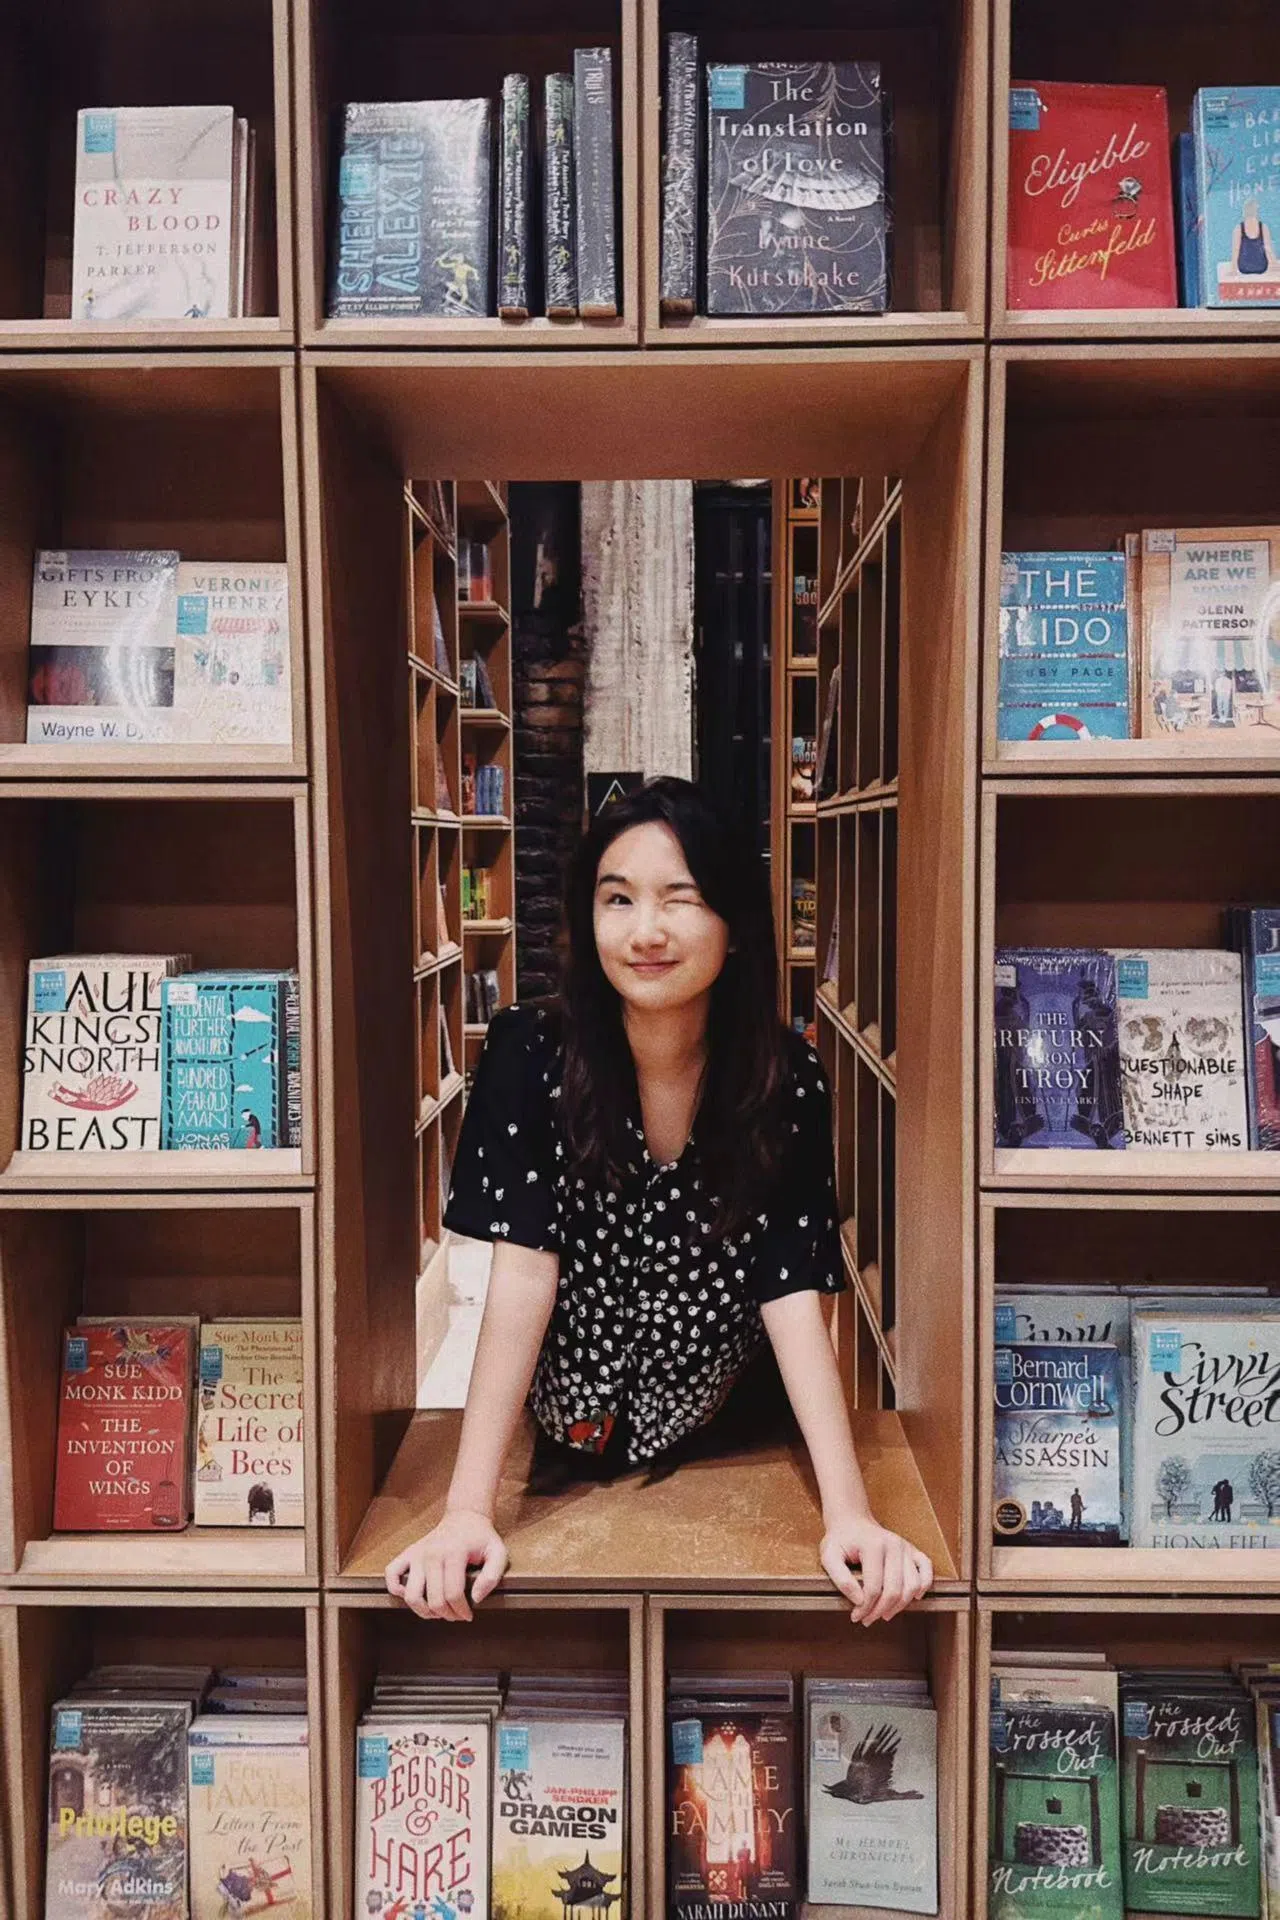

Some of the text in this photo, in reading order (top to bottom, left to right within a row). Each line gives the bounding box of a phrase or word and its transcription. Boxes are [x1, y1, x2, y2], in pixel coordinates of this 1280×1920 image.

[769, 78, 814, 101] The
[717, 114, 867, 138] Translation
[742, 149, 843, 172] of Love
[1024, 123, 1150, 208] Eligible
[83, 188, 183, 207] CRAZY
[128, 215, 221, 231] BLOOD
[376, 134, 424, 293] ALEXIE
[758, 226, 830, 250] Lynne
[1057, 219, 1109, 245] Curtis
[117, 243, 217, 256] JEFFERSON
[1029, 218, 1156, 286] Sittenfeld
[87, 265, 157, 277] PARKER
[728, 261, 860, 288] Kutsukake
[1187, 549, 1255, 563] WHERE
[114, 568, 157, 582] FRO
[1019, 570, 1097, 598] THE
[1184, 567, 1256, 581] ARE WE
[192, 577, 284, 592] VERONIC
[64, 590, 149, 608] EYKIS
[211, 595, 284, 610] HENRY
[1198, 605, 1244, 615] GLENN
[1015, 617, 1111, 646] LIDO
[1182, 619, 1257, 629] PATTERSON
[1071, 668, 1113, 677] PAGE
[42, 723, 94, 740] Wayne
[101, 723, 118, 737] W.
[64, 971, 162, 1013] AUL
[175, 1018, 228, 1036] FURTHER
[1038, 1013, 1068, 1025] THE
[32, 1016, 162, 1044] KINGS
[1000, 1029, 1104, 1048] RETURN
[23, 1047, 159, 1073] SNORTH
[1016, 1068, 1093, 1089] TROY
[1015, 1096, 1099, 1105] LINDSAY CLARKE
[1151, 1083, 1203, 1105] SHAPE
[177, 1111, 227, 1128] MAN
[29, 1117, 158, 1150] BEAST
[176, 1133, 230, 1143] JONAS
[1123, 1130, 1195, 1147] BENNETT
[214, 1330, 304, 1342] Sue Monk Ki
[104, 1365, 143, 1379] SUE
[242, 1367, 284, 1386] The
[1012, 1353, 1089, 1380] Bernard
[1163, 1342, 1280, 1397] Civvy
[65, 1386, 183, 1400] MONK KIDD
[221, 1384, 304, 1410] Secret
[994, 1375, 1107, 1408] Cornwell
[1155, 1388, 1280, 1437] Street
[101, 1418, 142, 1433] THE
[216, 1416, 304, 1443] Life of
[67, 1440, 175, 1455] INVENTION
[1009, 1418, 1099, 1458] Sharpe's
[105, 1460, 134, 1476] OF
[231, 1450, 292, 1476] Bees
[995, 1448, 1109, 1468] ASSASSIN
[88, 1481, 151, 1495] WINGS
[1153, 1536, 1219, 1549] FIONA
[1159, 1702, 1183, 1716] the
[1019, 1715, 1040, 1728] the
[1197, 1730, 1243, 1758] Out
[1057, 1744, 1104, 1774] Out
[370, 1755, 471, 1822] BEGGAR
[544, 1786, 618, 1797] JAN-PHILIPP
[552, 1795, 609, 1805] SENDKER
[208, 1810, 302, 1836] Letters From
[405, 1798, 438, 1836] &
[500, 1802, 617, 1824] DRAGON
[672, 1802, 793, 1844] FAMILY
[59, 1807, 178, 1844] Privilege
[509, 1819, 607, 1840] GAMES
[265, 1834, 303, 1854] Past
[370, 1826, 471, 1901] HARE
[829, 1851, 915, 1862] CHRONICLES
[1133, 1845, 1249, 1873] Notebook
[58, 1879, 173, 1898] Mary Adkins
[992, 1866, 1112, 1894] Notebook
[676, 1902, 789, 1920] SARAH DUNANT
